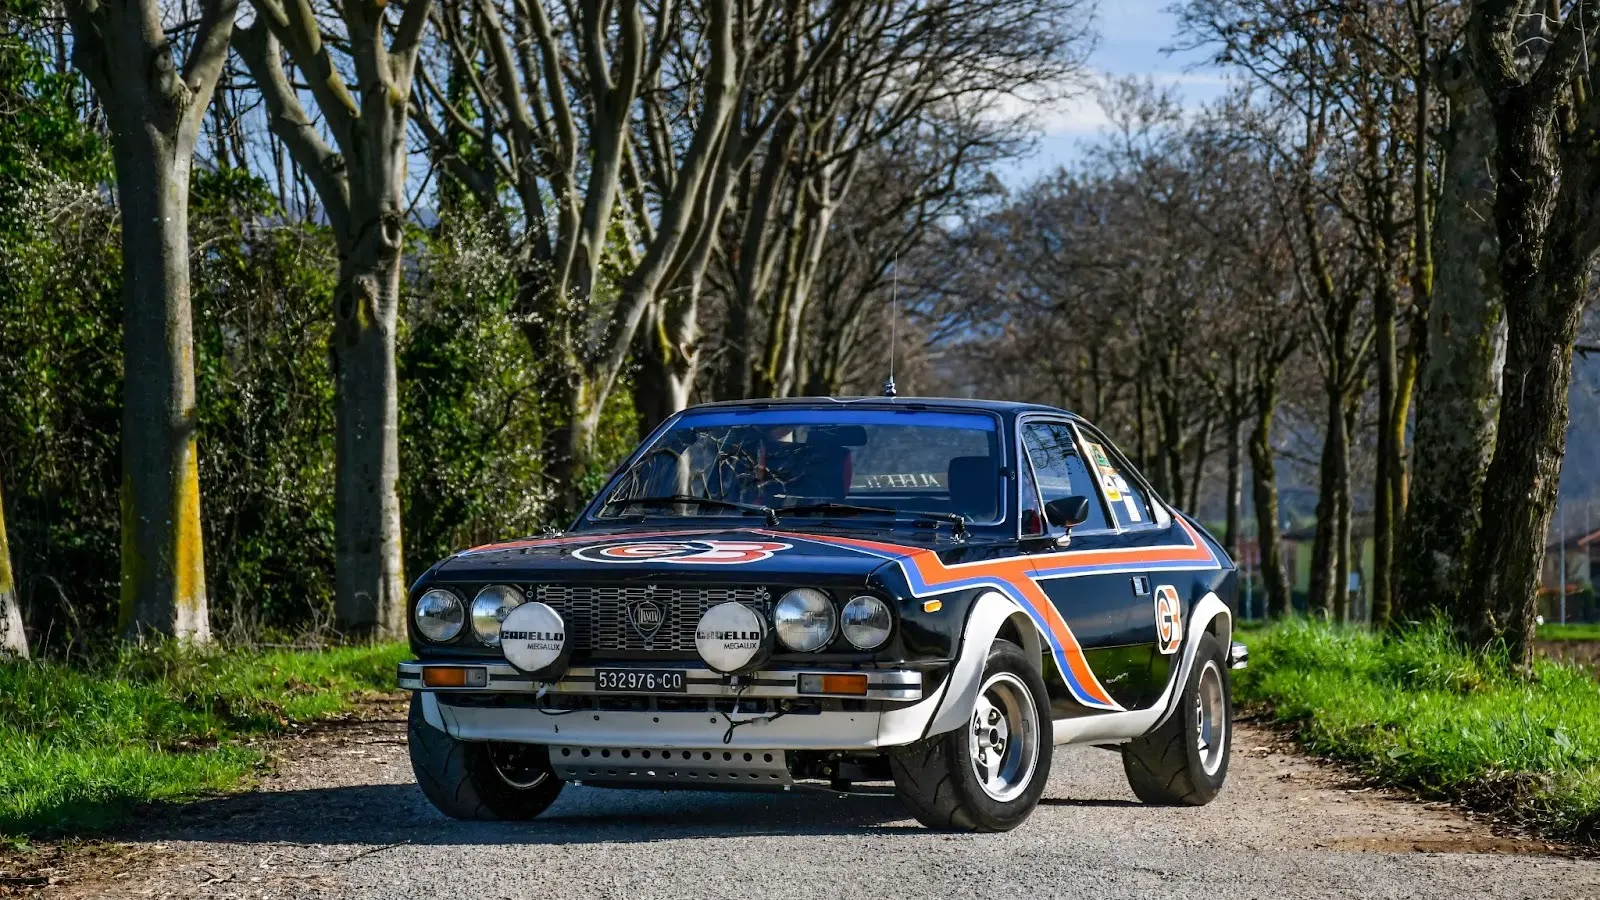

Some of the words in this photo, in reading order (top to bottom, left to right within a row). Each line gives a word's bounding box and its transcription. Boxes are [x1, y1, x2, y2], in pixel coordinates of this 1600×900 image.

[501, 630, 564, 641] CARELLO
[697, 631, 760, 641] CARELLO
[526, 642, 561, 651] MEGALUX
[723, 642, 757, 650] MEGALUX
[599, 671, 656, 689] 532976
